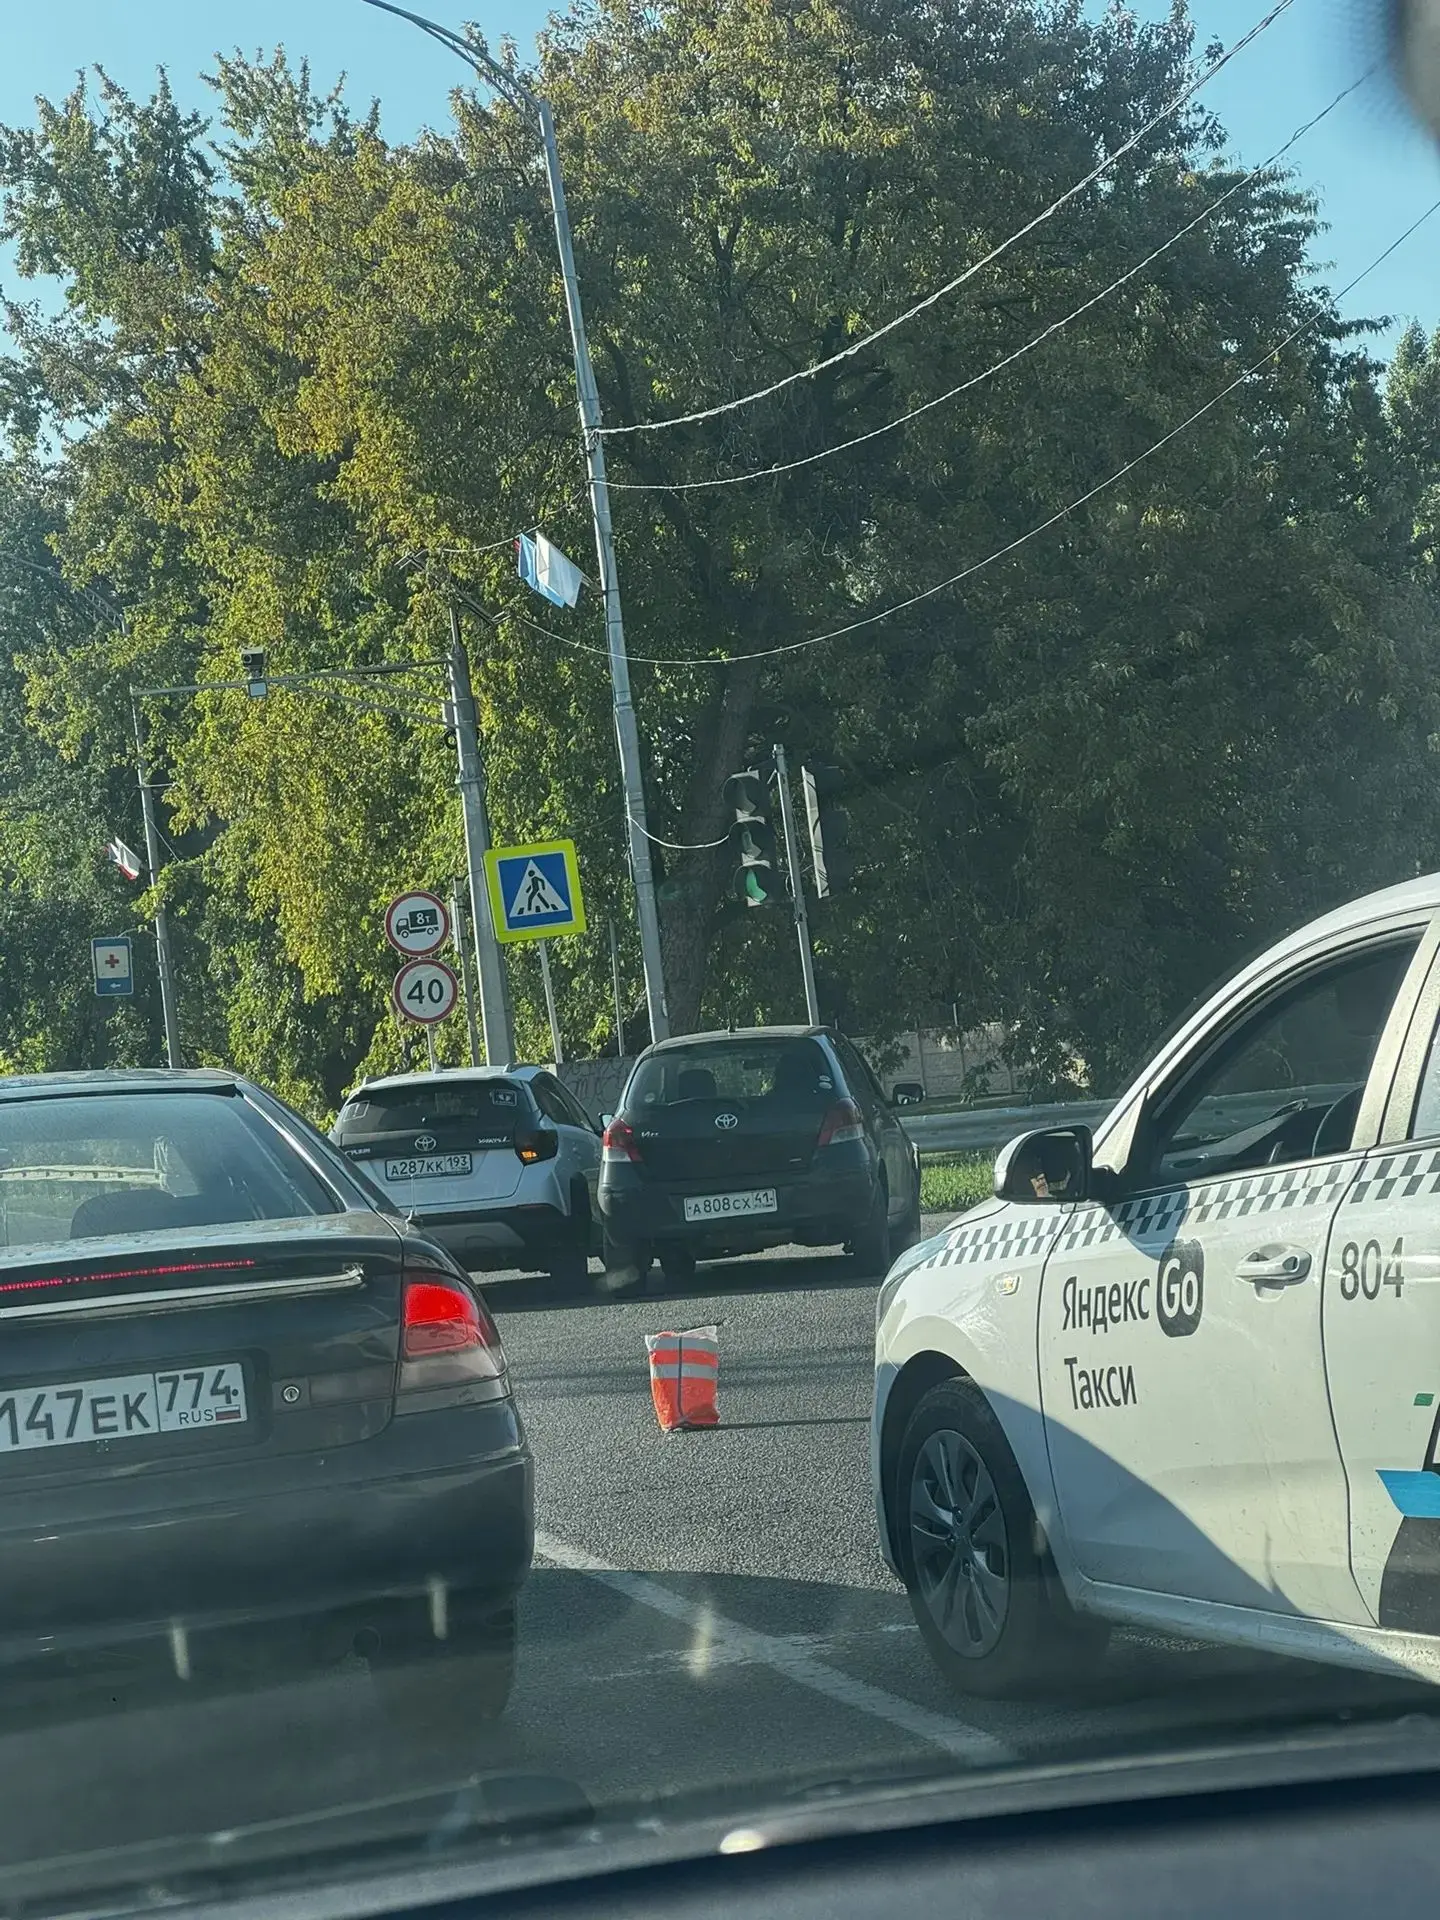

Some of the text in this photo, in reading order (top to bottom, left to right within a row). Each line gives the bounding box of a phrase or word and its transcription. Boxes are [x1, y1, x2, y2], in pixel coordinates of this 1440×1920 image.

[407, 978, 444, 1005] 40
[391, 1160, 444, 1176] А287КК
[693, 1197, 751, 1215] А808СХ
[1340, 1237, 1405, 1301] 804
[1062, 1257, 1200, 1335] Яндекс Go
[158, 1368, 233, 1413] 774
[1064, 1356, 1138, 1411] Такси
[178, 1408, 214, 1425] RUS
